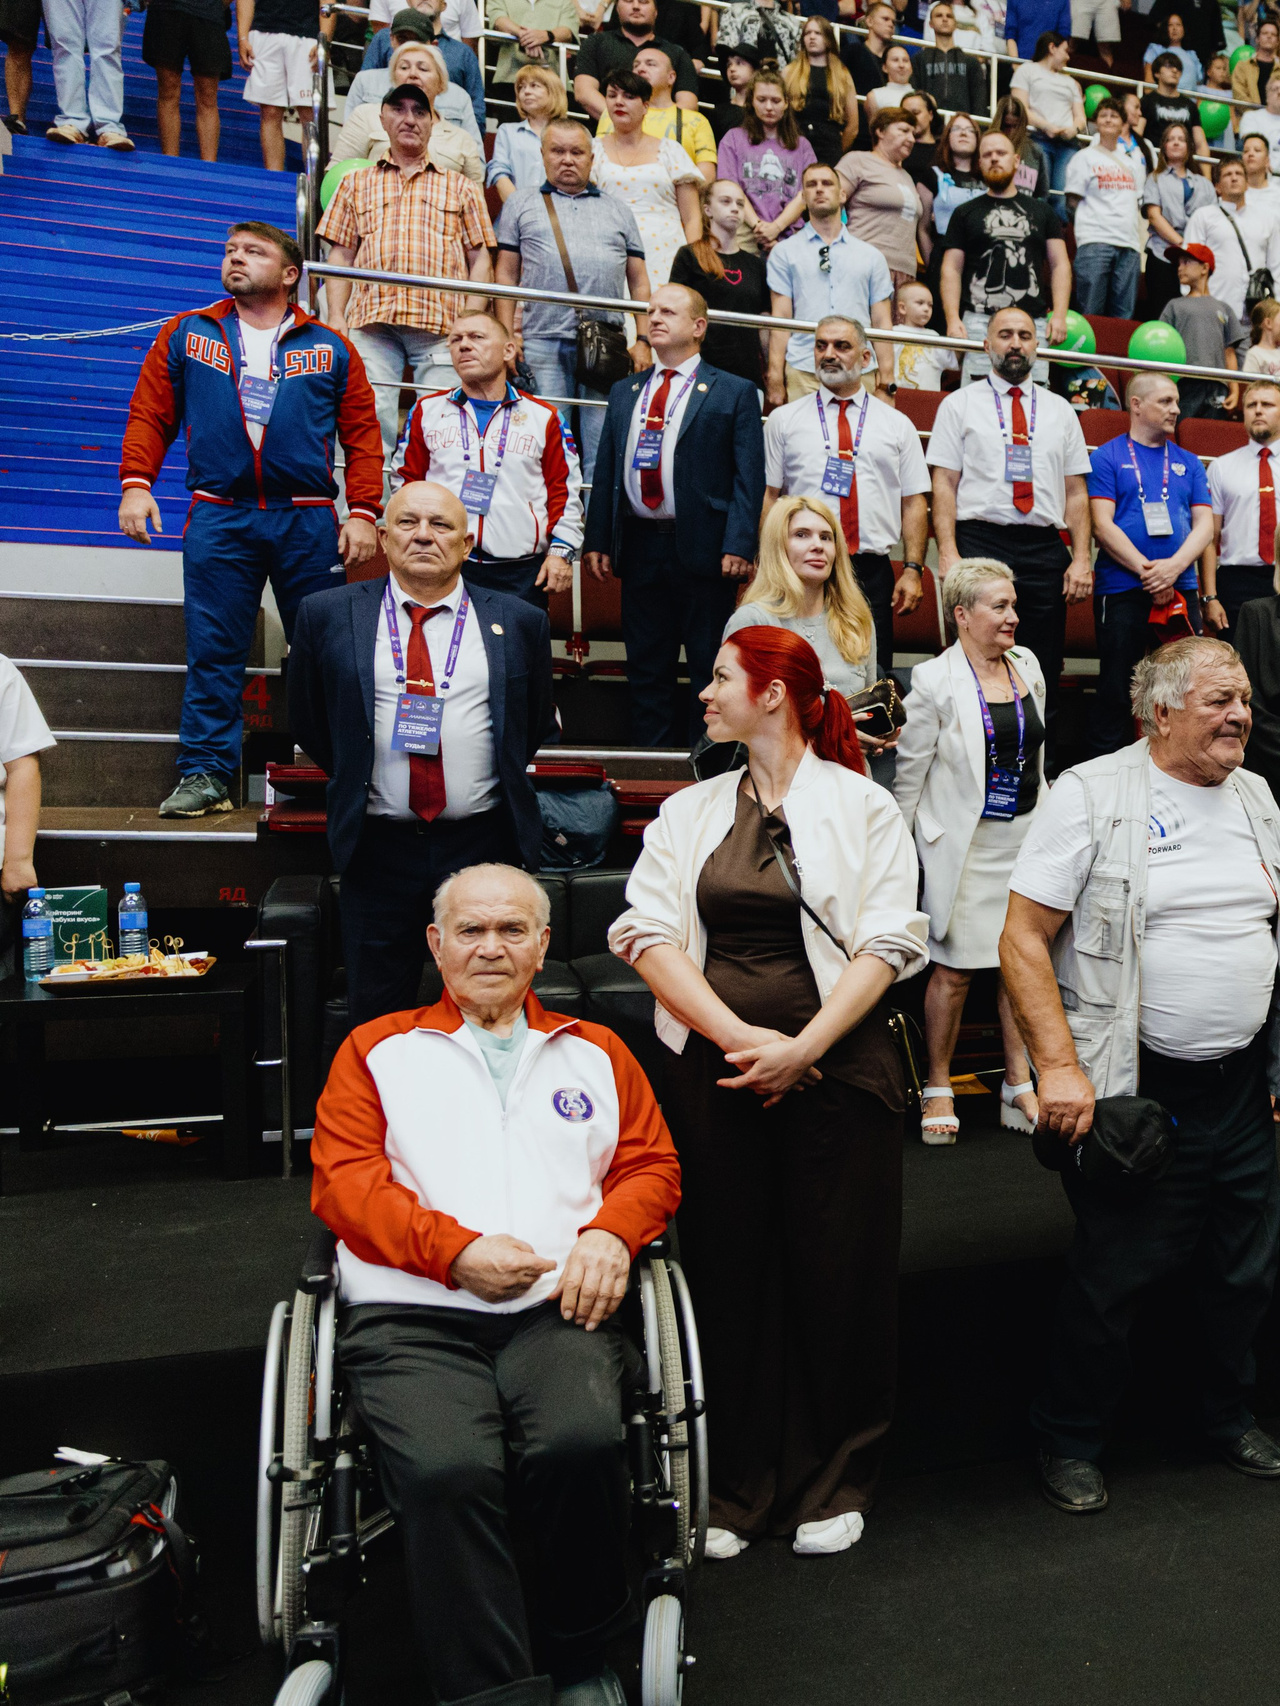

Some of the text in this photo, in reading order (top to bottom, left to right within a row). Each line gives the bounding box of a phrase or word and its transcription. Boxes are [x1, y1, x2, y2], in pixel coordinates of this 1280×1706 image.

[186, 332, 333, 379] RUS SIA
[242, 674, 271, 710] 4
